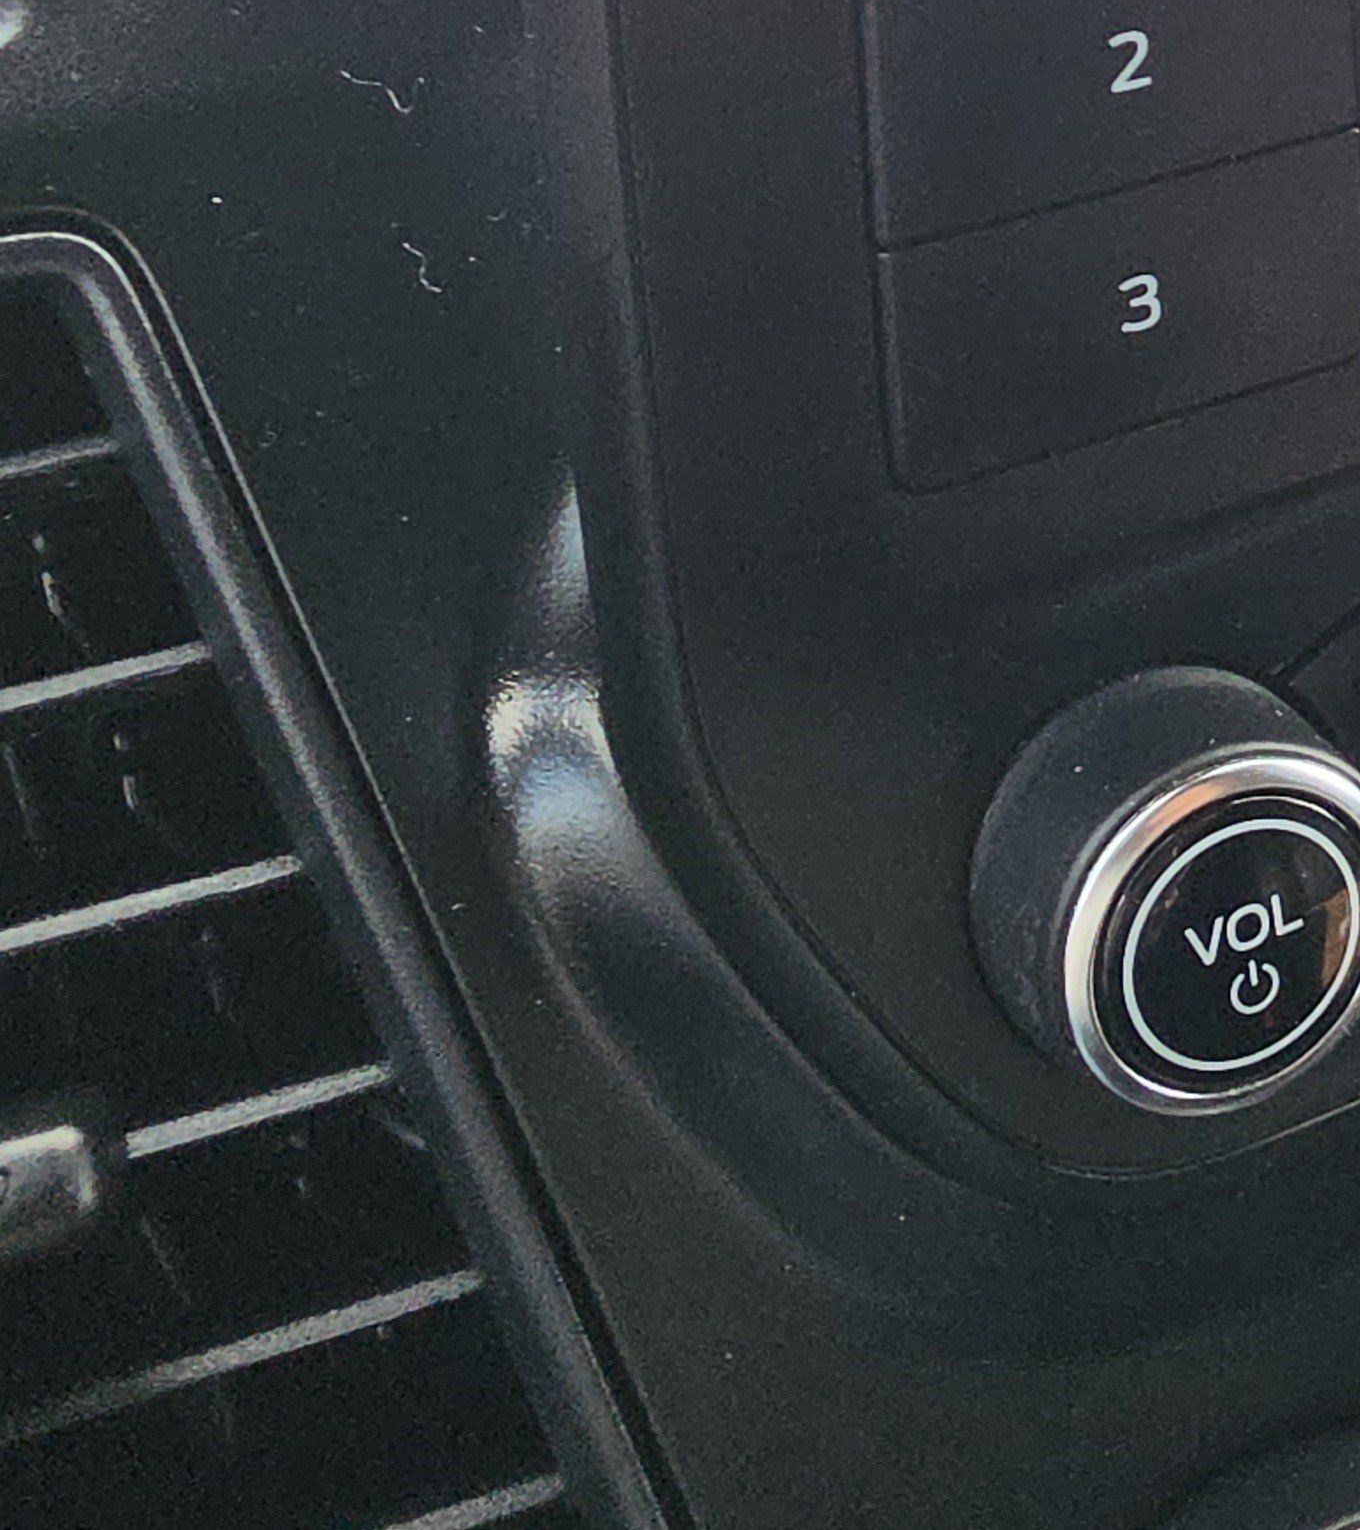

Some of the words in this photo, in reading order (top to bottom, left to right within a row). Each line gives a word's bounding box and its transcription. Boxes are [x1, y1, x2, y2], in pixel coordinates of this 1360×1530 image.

[1108, 30, 1153, 94] 2
[1117, 273, 1163, 334] 3
[1184, 894, 1304, 967] VOL
